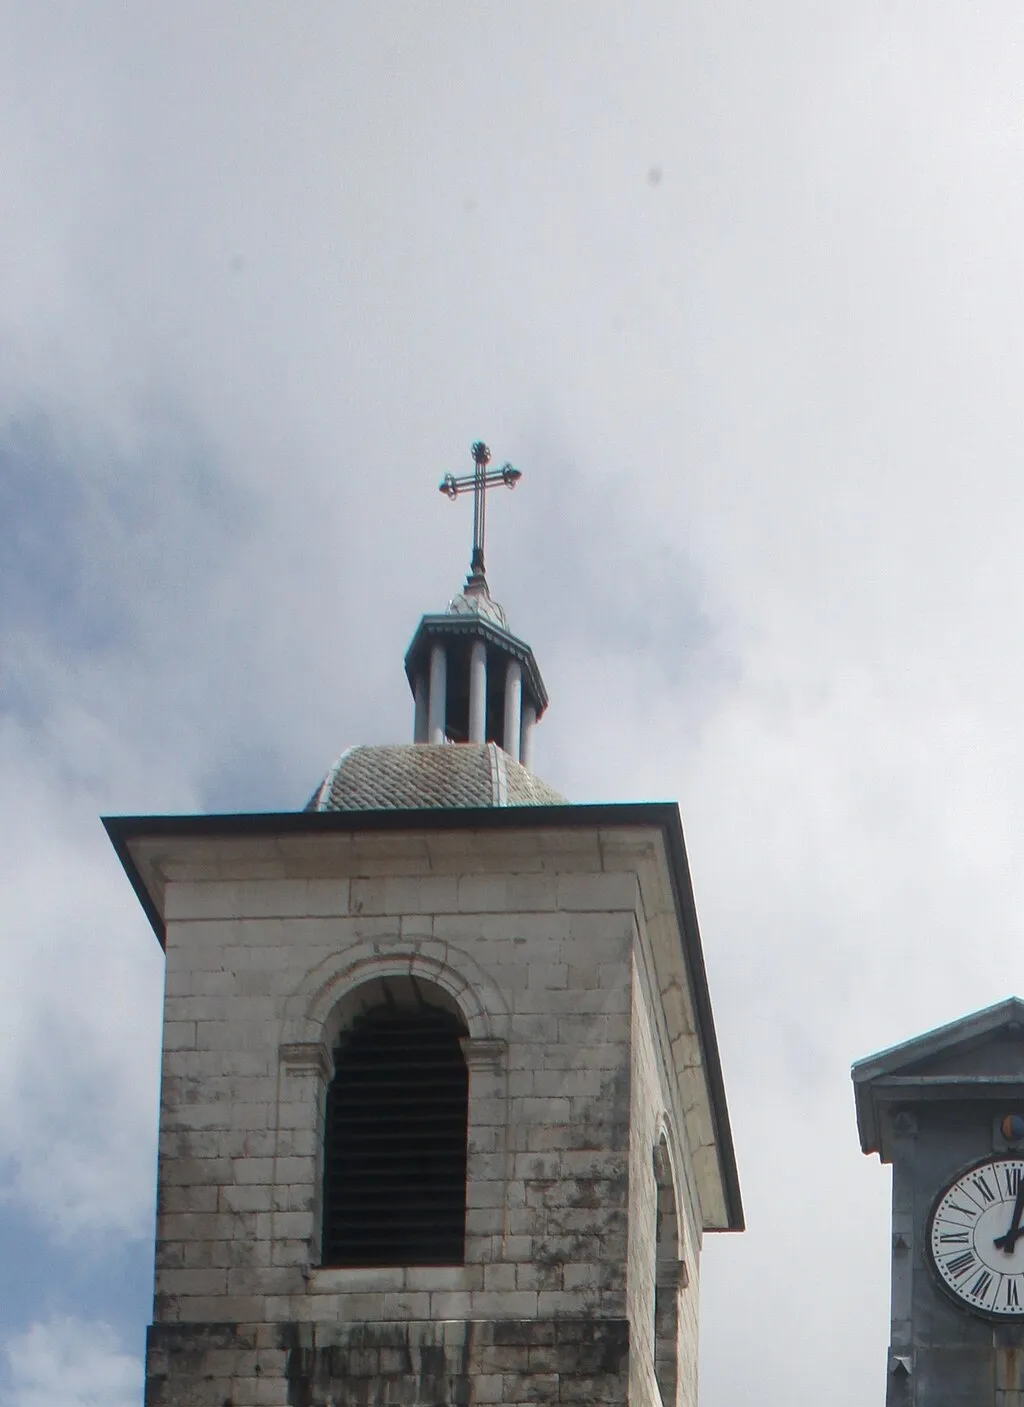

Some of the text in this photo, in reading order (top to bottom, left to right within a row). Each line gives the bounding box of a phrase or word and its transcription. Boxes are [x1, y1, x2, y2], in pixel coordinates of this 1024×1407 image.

[972, 1176, 995, 1204] XI
[948, 1201, 977, 1221] X
[1007, 1278, 1019, 1306] VI
